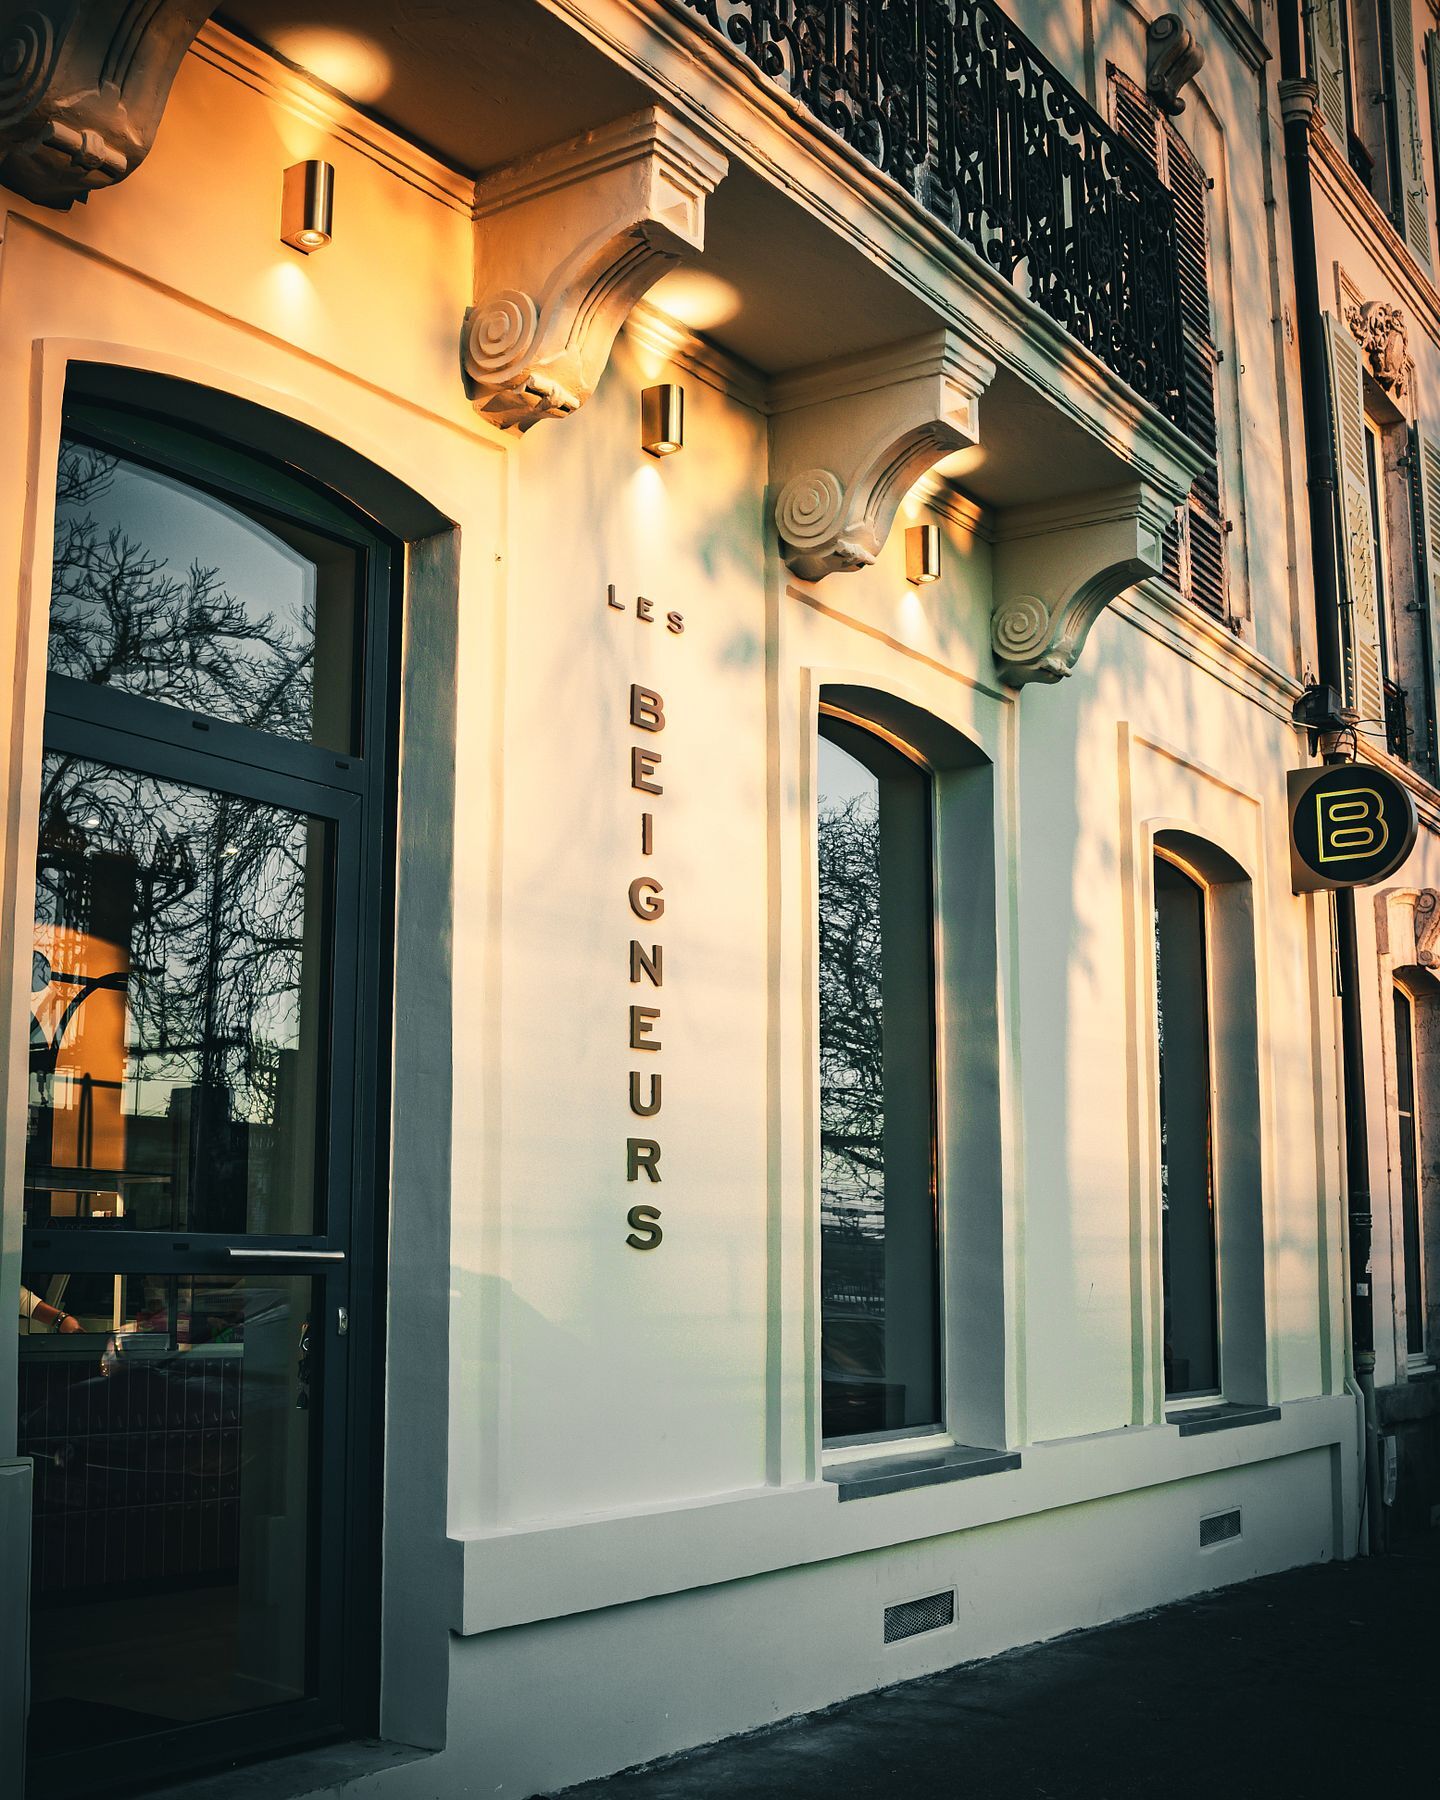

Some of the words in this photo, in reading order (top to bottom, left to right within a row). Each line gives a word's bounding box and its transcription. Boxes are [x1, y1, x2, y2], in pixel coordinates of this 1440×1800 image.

[608, 584, 685, 634] LES
[1316, 787, 1389, 863] B
[626, 683, 666, 1251] BEIGNEURS
